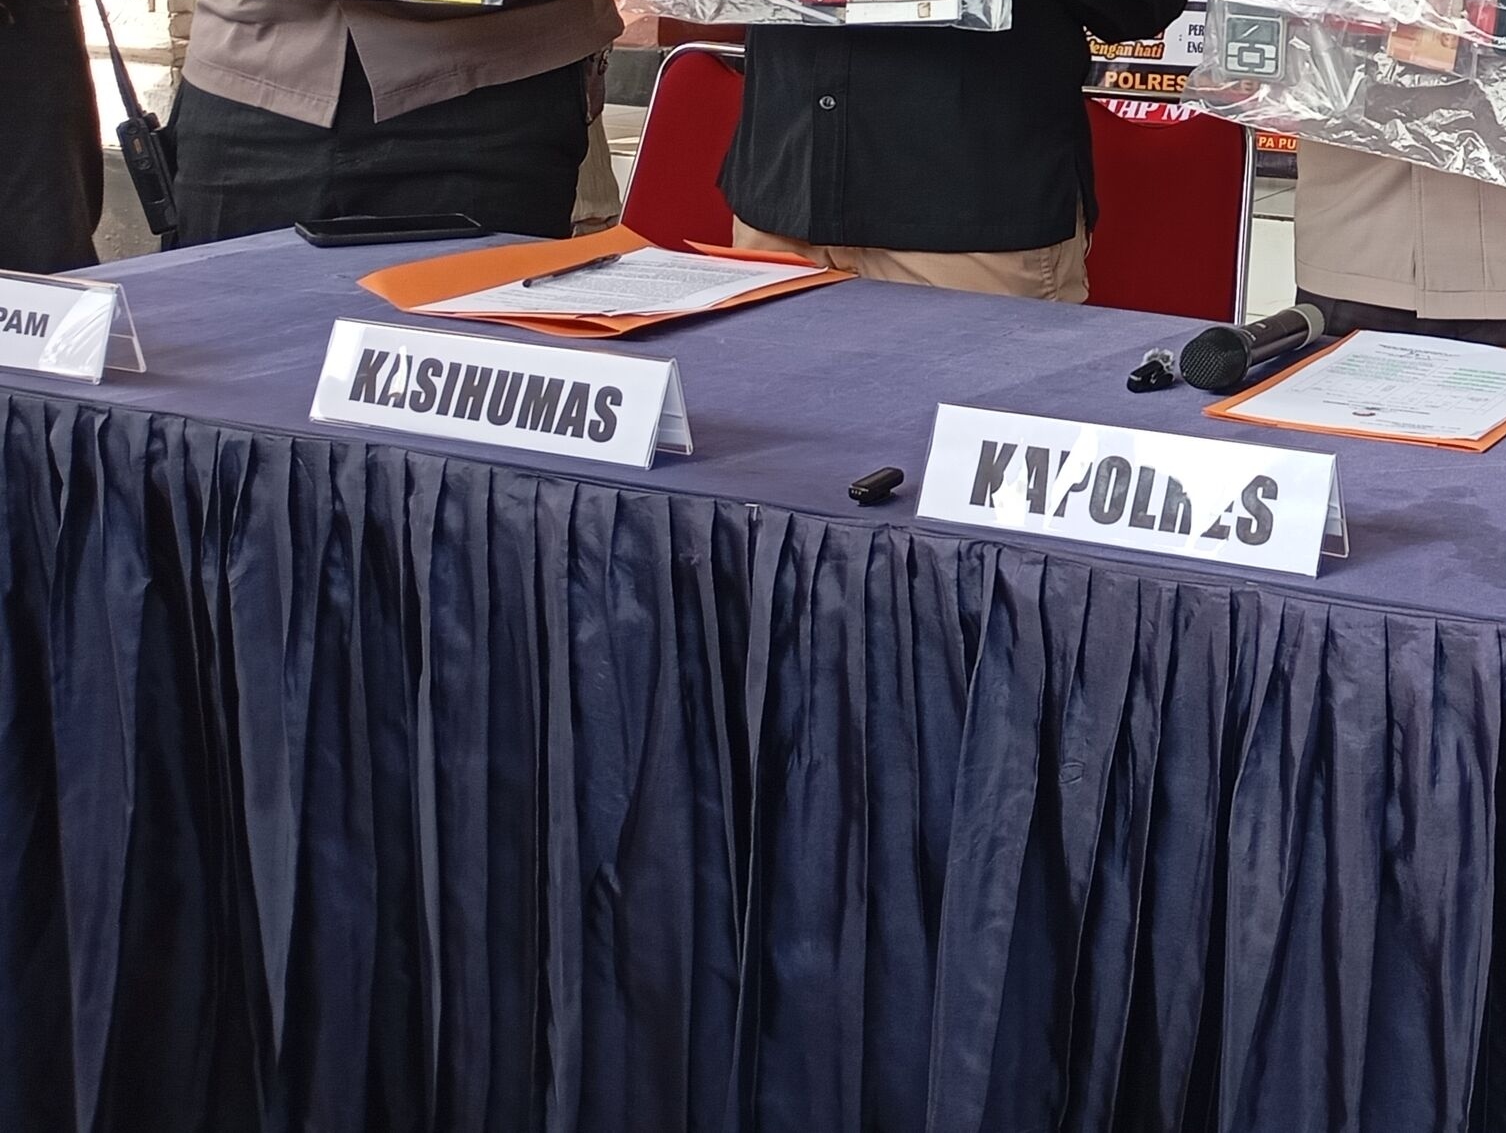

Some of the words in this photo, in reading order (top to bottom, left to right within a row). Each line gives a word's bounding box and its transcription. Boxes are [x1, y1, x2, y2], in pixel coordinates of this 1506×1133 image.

[1136, 41, 1164, 60] hati
[1105, 71, 1188, 92] POLRES
[349, 347, 624, 443] KASIHUMAS
